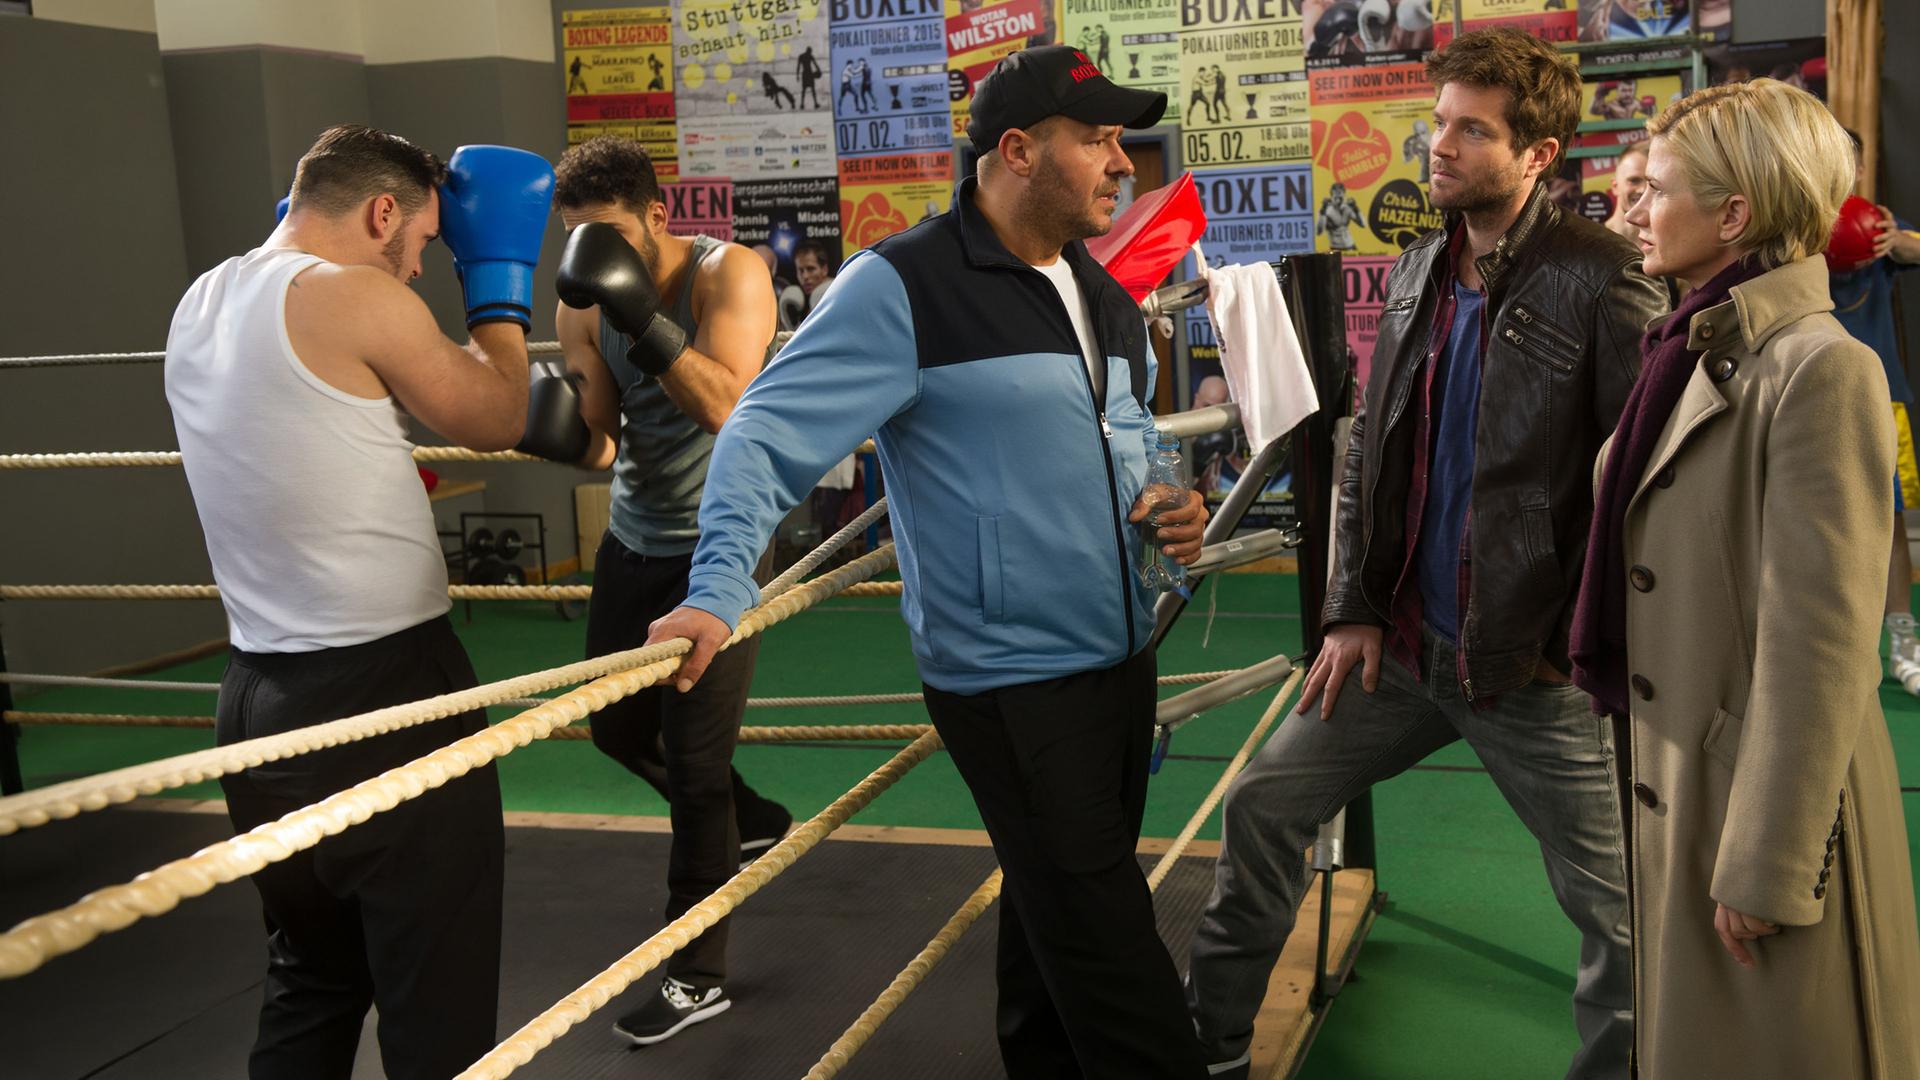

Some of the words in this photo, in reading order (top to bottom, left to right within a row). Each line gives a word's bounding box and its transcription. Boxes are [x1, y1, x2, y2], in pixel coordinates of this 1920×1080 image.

[970, 8, 1008, 26] WOTAN
[567, 27, 612, 47] BOXING
[614, 25, 668, 45] LEGENDS
[679, 31, 746, 58] schaut
[757, 18, 802, 42] hin!
[831, 27, 910, 48] POKALTURNIER
[913, 24, 941, 42] 2015
[949, 12, 1035, 51] WILSTON
[1182, 31, 1269, 55] POKALTURNIER
[1315, 77, 1335, 91] SEE
[1338, 75, 1349, 89] IT
[1352, 73, 1382, 88] NOW
[1386, 71, 1404, 86] ON
[1408, 70, 1432, 84] FIL
[840, 120, 896, 151] 07.02.
[1187, 131, 1251, 163] 05.02.
[843, 159, 861, 174] SEE
[862, 159, 873, 173] IT
[875, 158, 900, 172] NOW
[902, 156, 918, 170] ON
[919, 155, 950, 168] FILM!
[1337, 153, 1388, 182] RUMBLER
[659, 186, 727, 218] XEN
[732, 214, 769, 226] Dennis
[797, 211, 839, 223] Mladen
[732, 229, 771, 241] Panker
[806, 225, 839, 238] Steko
[1278, 221, 1308, 239] 2015
